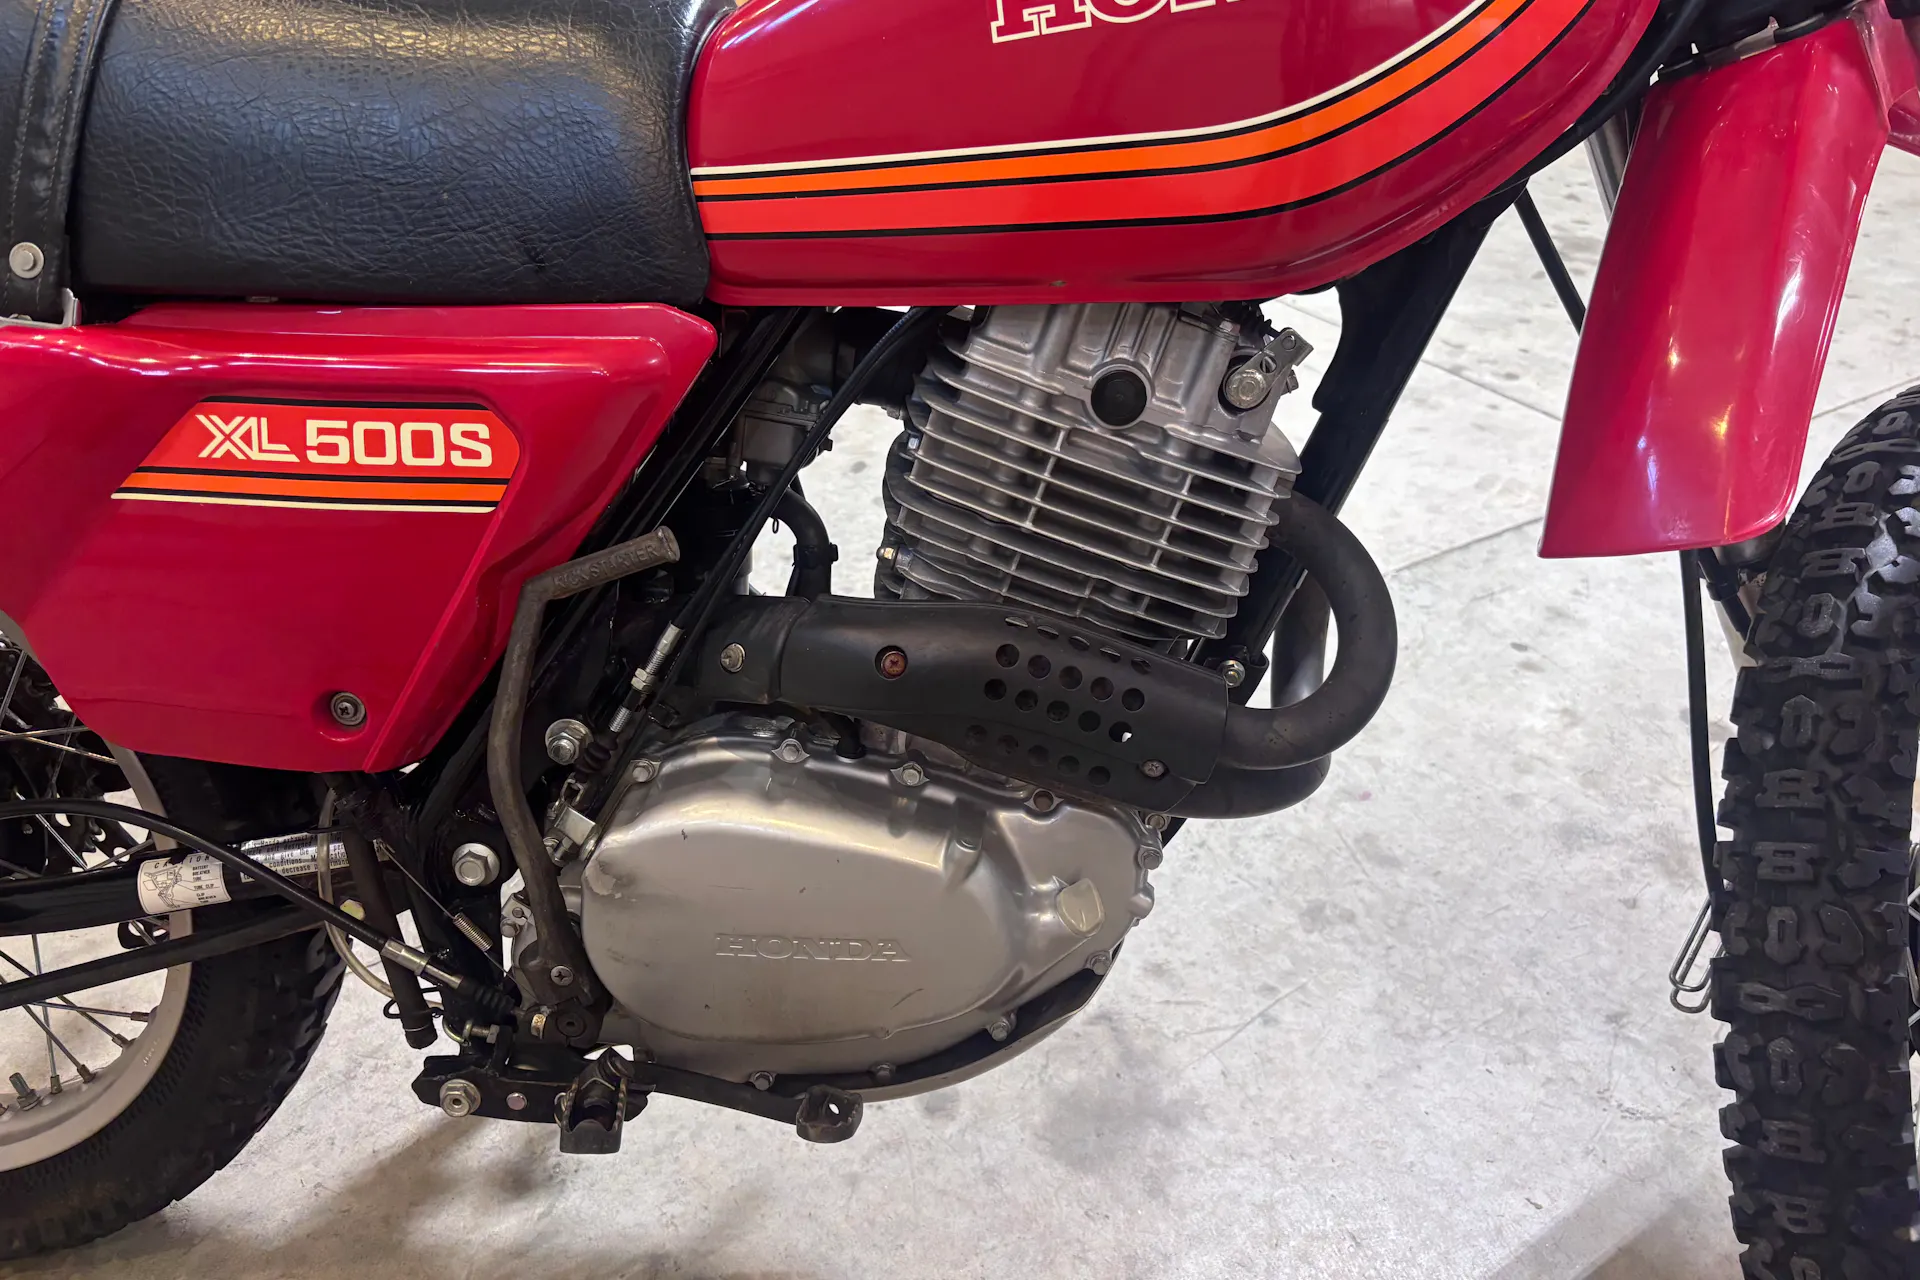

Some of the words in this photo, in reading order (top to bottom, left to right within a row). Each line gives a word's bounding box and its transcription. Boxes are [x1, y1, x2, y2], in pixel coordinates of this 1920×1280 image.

[195, 414, 300, 462] XL
[305, 419, 493, 468] 500S
[590, 543, 661, 577] STARTER
[154, 854, 210, 869] CAION
[281, 864, 311, 874] decrease
[714, 933, 911, 963] HONDA
